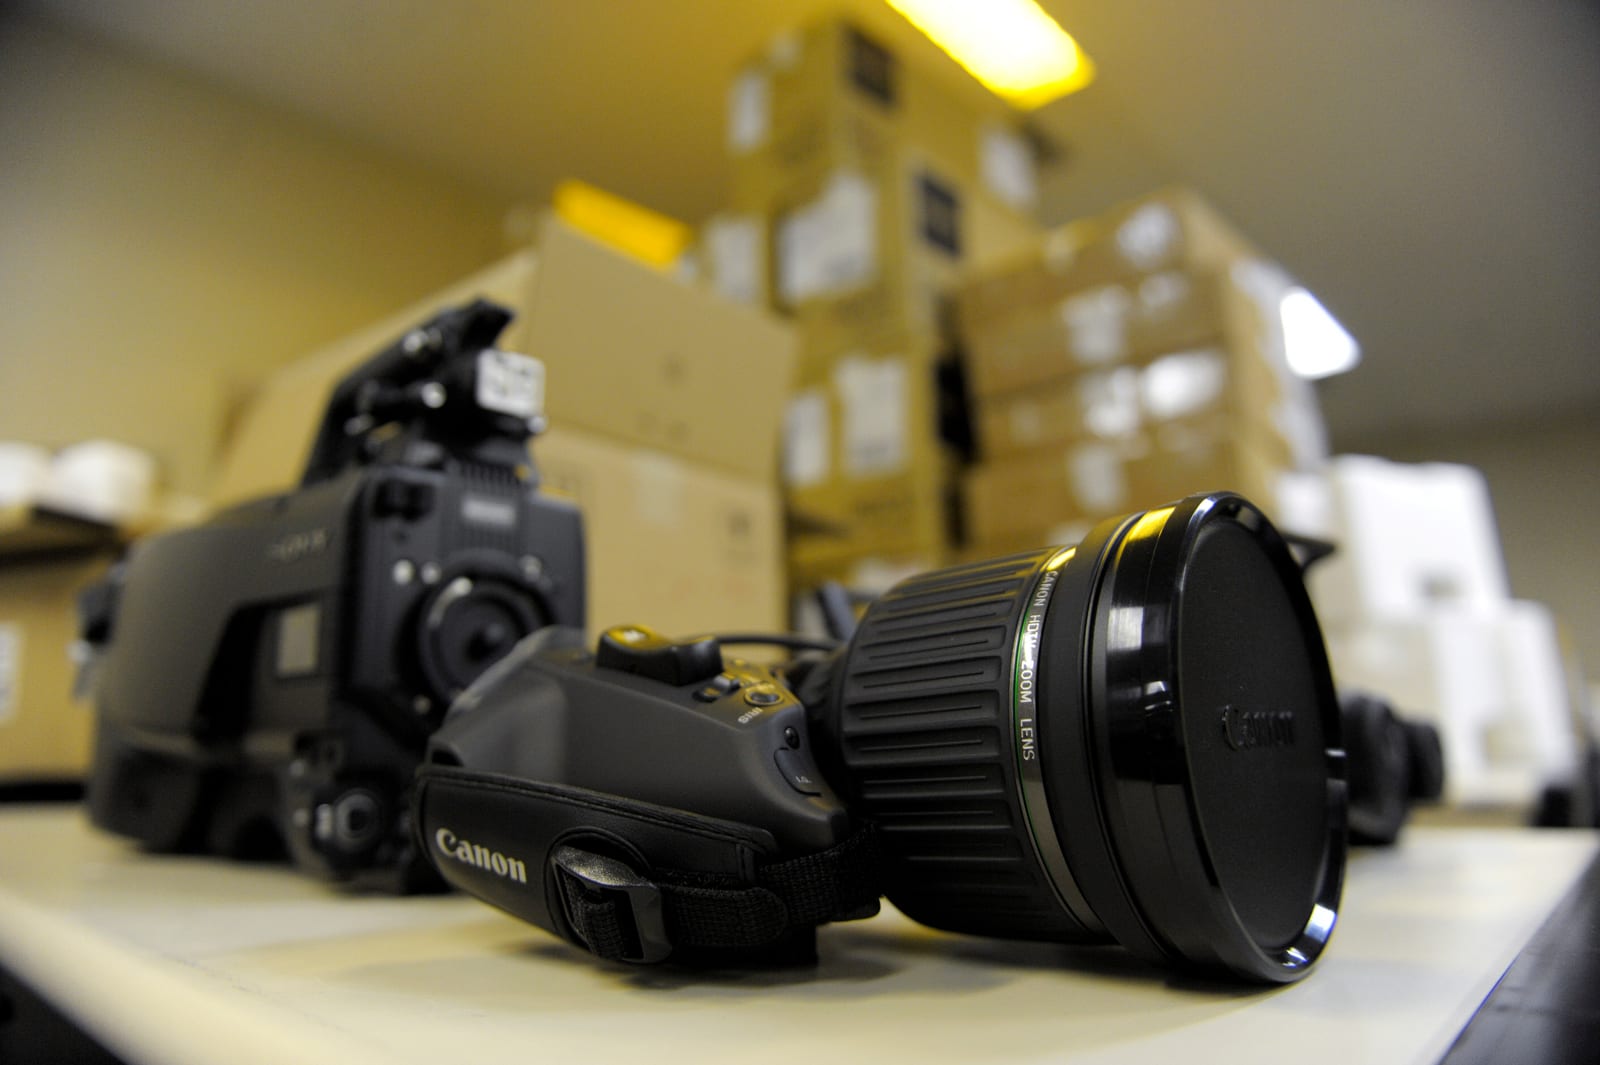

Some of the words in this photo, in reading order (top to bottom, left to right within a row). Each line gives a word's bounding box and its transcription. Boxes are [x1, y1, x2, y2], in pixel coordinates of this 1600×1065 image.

[1034, 571, 1058, 606] CANON
[1020, 661, 1034, 703] ZOOM
[1020, 718, 1035, 760] LENS
[1221, 704, 1295, 752] Canon
[436, 828, 527, 883] Canon
